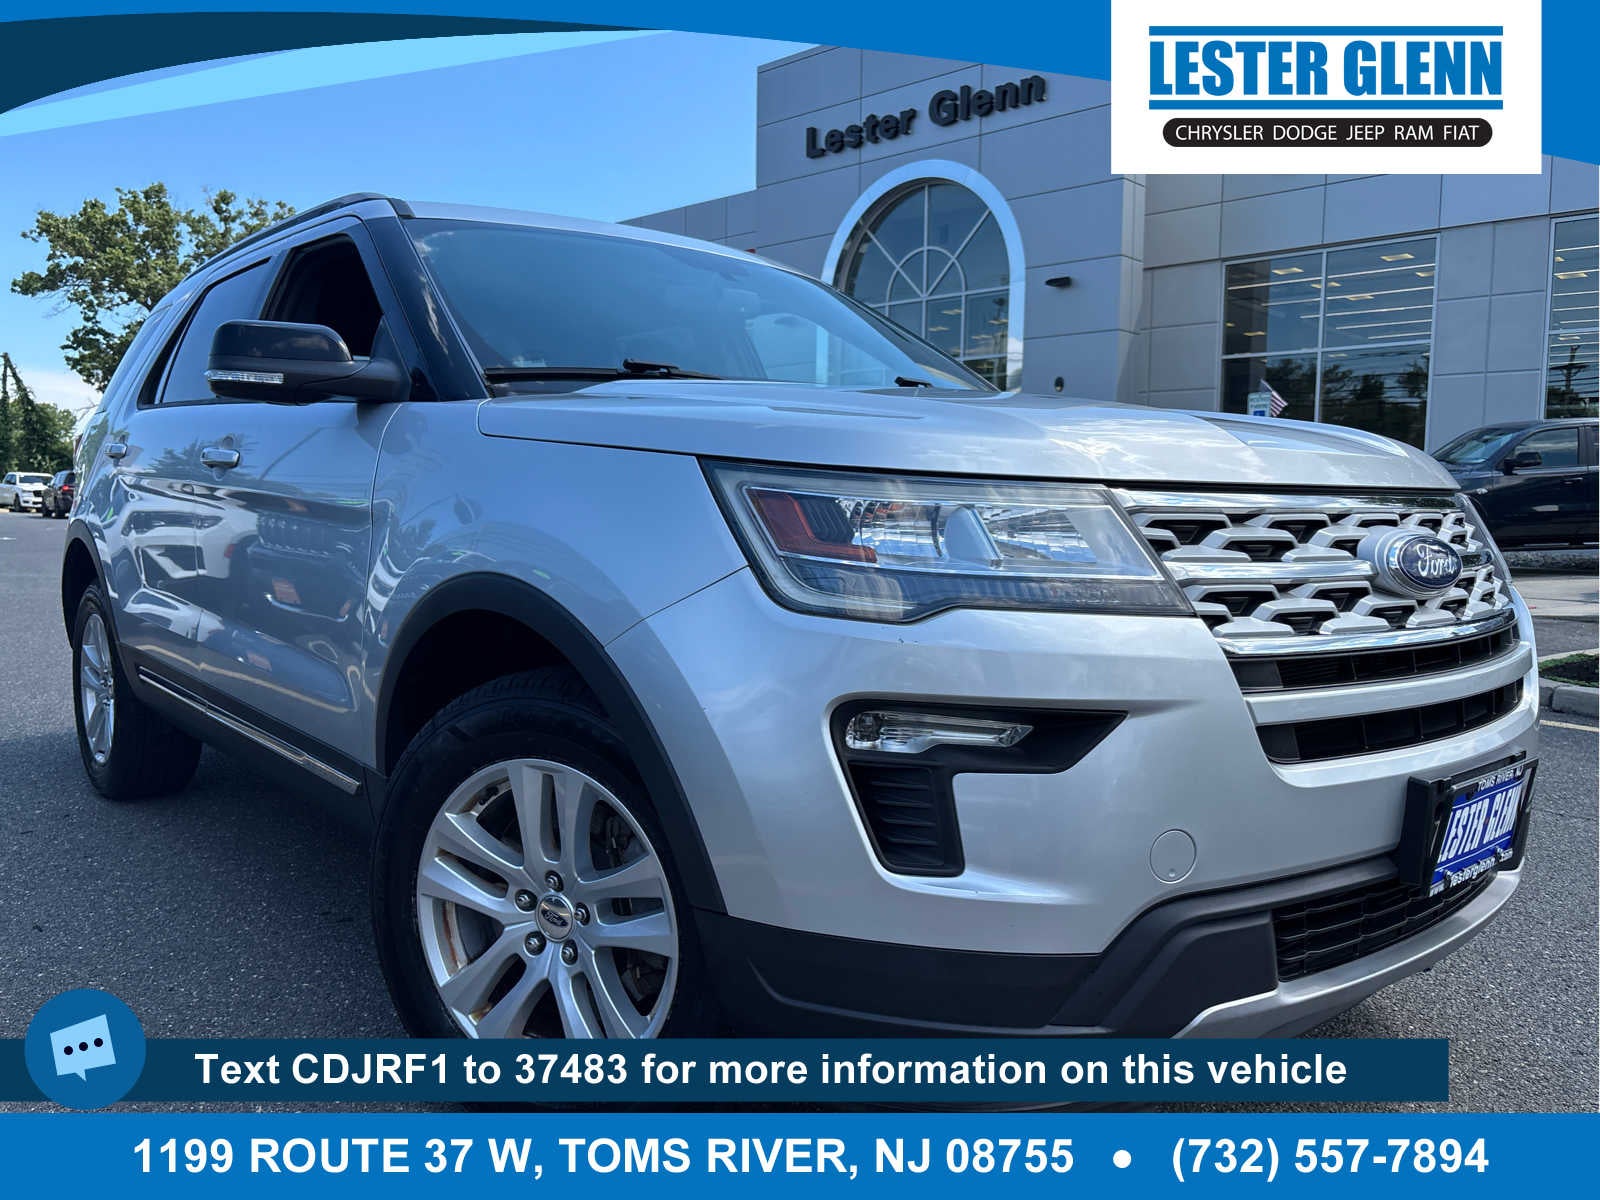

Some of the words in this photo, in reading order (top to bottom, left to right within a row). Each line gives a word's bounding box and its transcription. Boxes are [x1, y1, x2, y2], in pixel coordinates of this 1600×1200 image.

[806, 108, 917, 159] Lester
[929, 75, 1047, 127] Glenn
[1416, 543, 1457, 577] Ford
[1477, 774, 1497, 792] TOMS
[1483, 784, 1521, 844] GLENN
